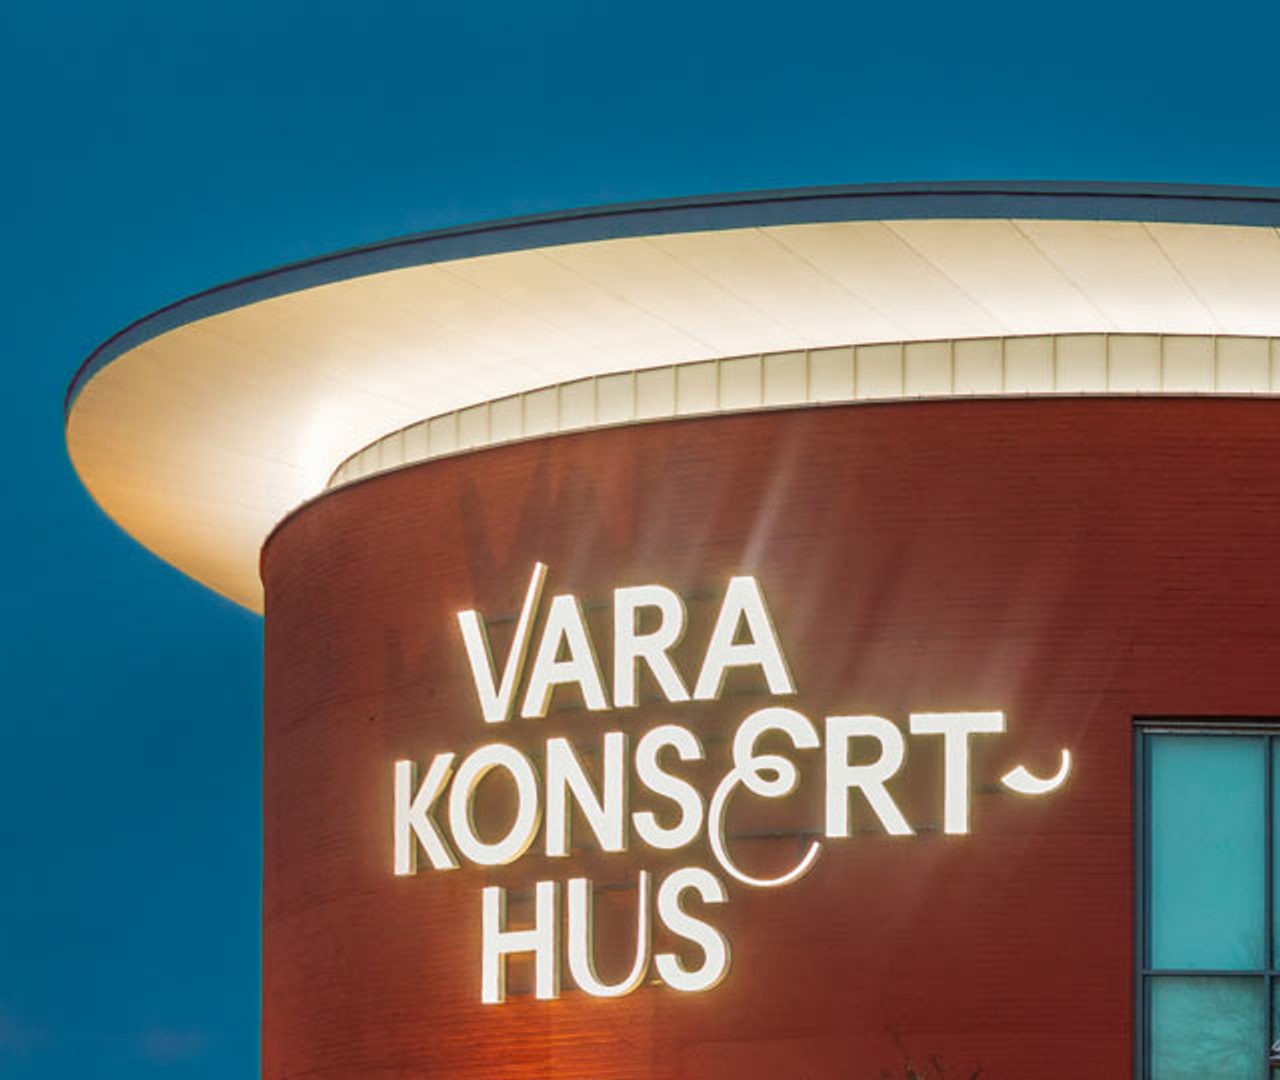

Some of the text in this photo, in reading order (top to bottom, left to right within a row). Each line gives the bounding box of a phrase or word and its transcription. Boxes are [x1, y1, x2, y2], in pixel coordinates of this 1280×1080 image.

[456, 561, 796, 724] VARA
[393, 706, 1072, 887] KONSERT
[481, 867, 732, 1004] HUS
